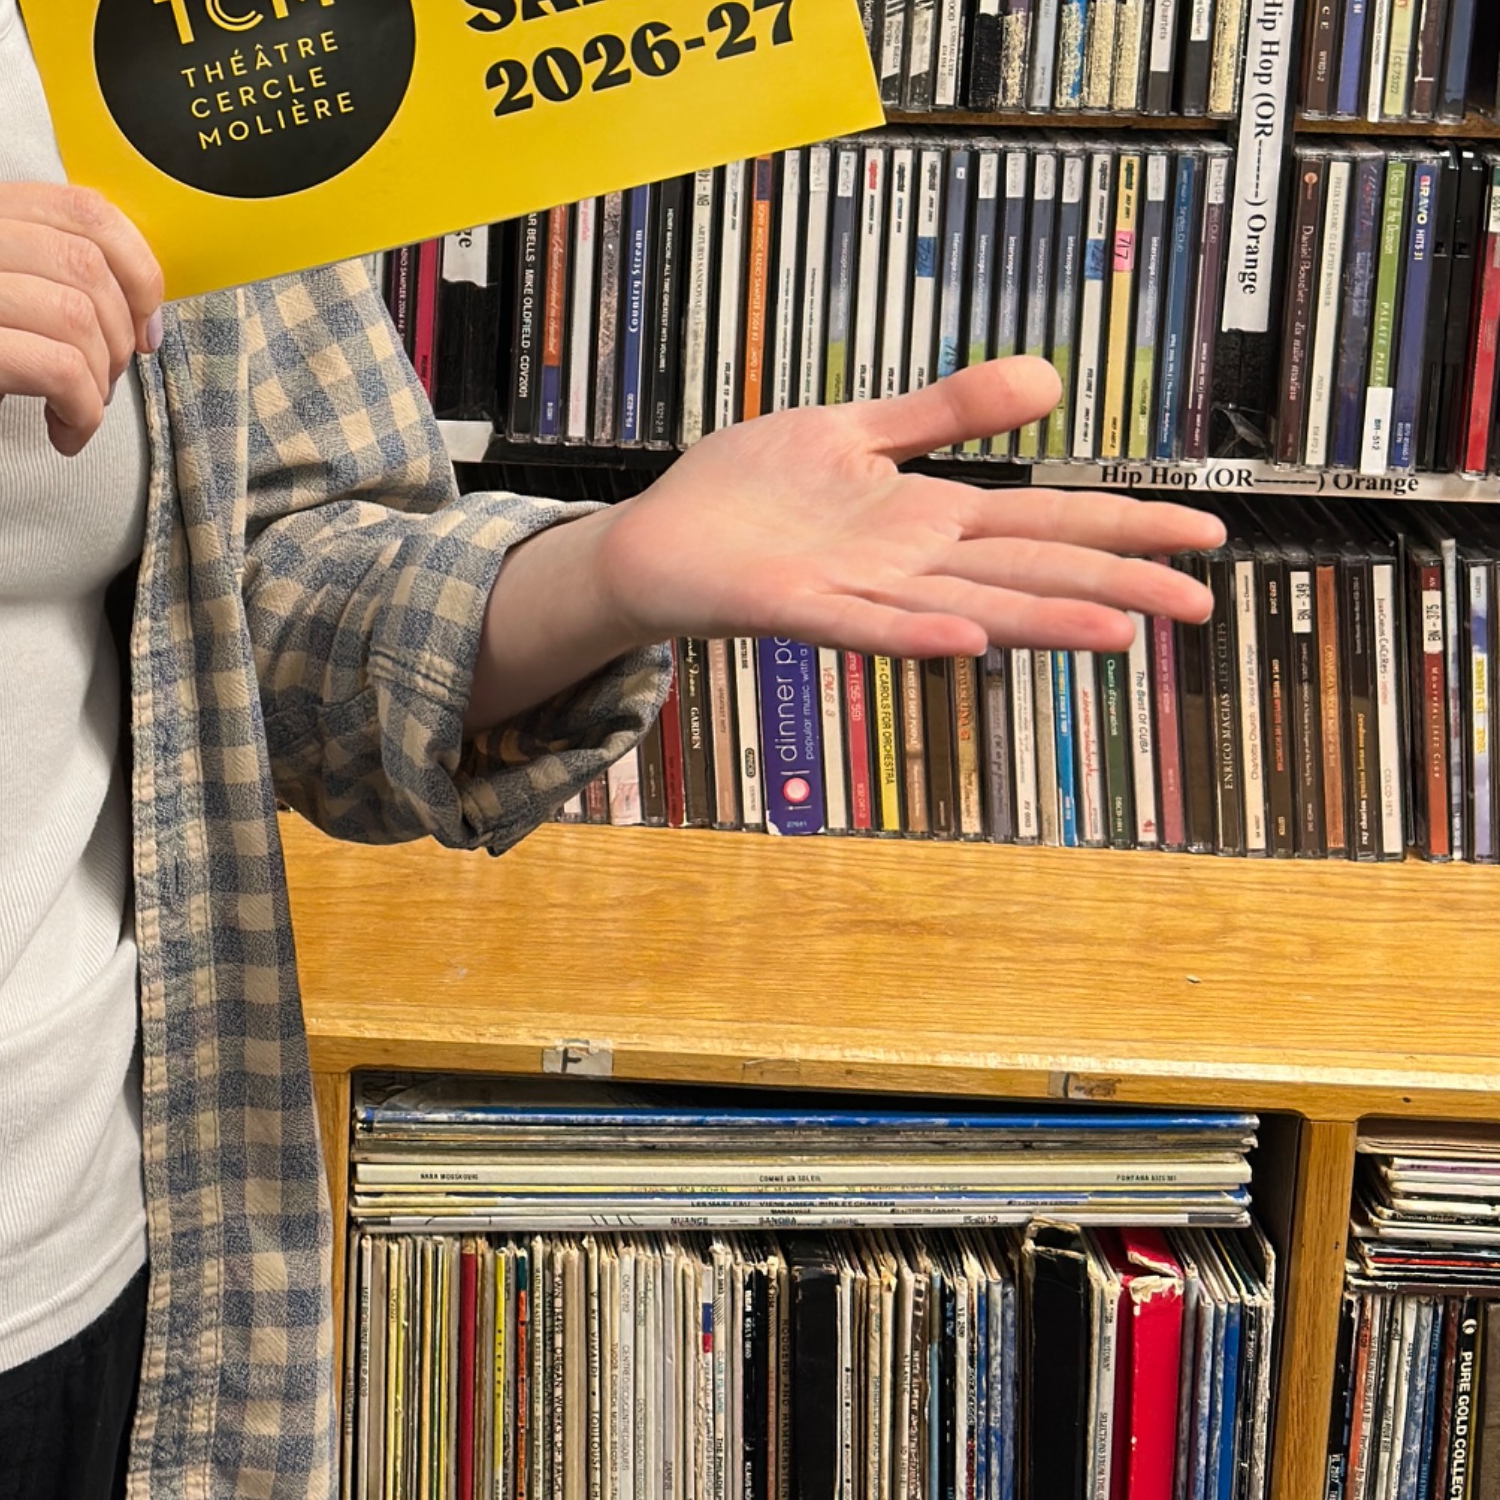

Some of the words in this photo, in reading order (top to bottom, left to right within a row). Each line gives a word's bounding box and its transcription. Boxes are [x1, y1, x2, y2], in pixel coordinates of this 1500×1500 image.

[182, 30, 339, 90] THÉÂTRE
[1250, 39, 1281, 87] Hop
[191, 70, 326, 118] CERCLE
[198, 93, 355, 149] MOLIÈRE
[523, 228, 536, 262] BELLS
[1240, 214, 1263, 295] Orange
[522, 269, 534, 295] MIKE
[519, 297, 532, 348] OLDFIELD
[1101, 466, 1141, 487] Hip
[1150, 466, 1196, 489] Hop
[1333, 472, 1418, 494] Orange
[801, 682, 812, 716] music
[878, 673, 889, 709] CAROLS
[1135, 670, 1146, 688] The
[774, 675, 795, 762] dinner
[881, 710, 891, 729] FOR
[1135, 690, 1146, 711] Best
[801, 718, 814, 760] popular
[882, 731, 894, 785] ORCHESTRA
[1138, 726, 1148, 754] CUBA
[1458, 1351, 1473, 1393] PURE
[1454, 1395, 1470, 1436] GOLD
[1449, 1438, 1467, 1500] COLLECT
